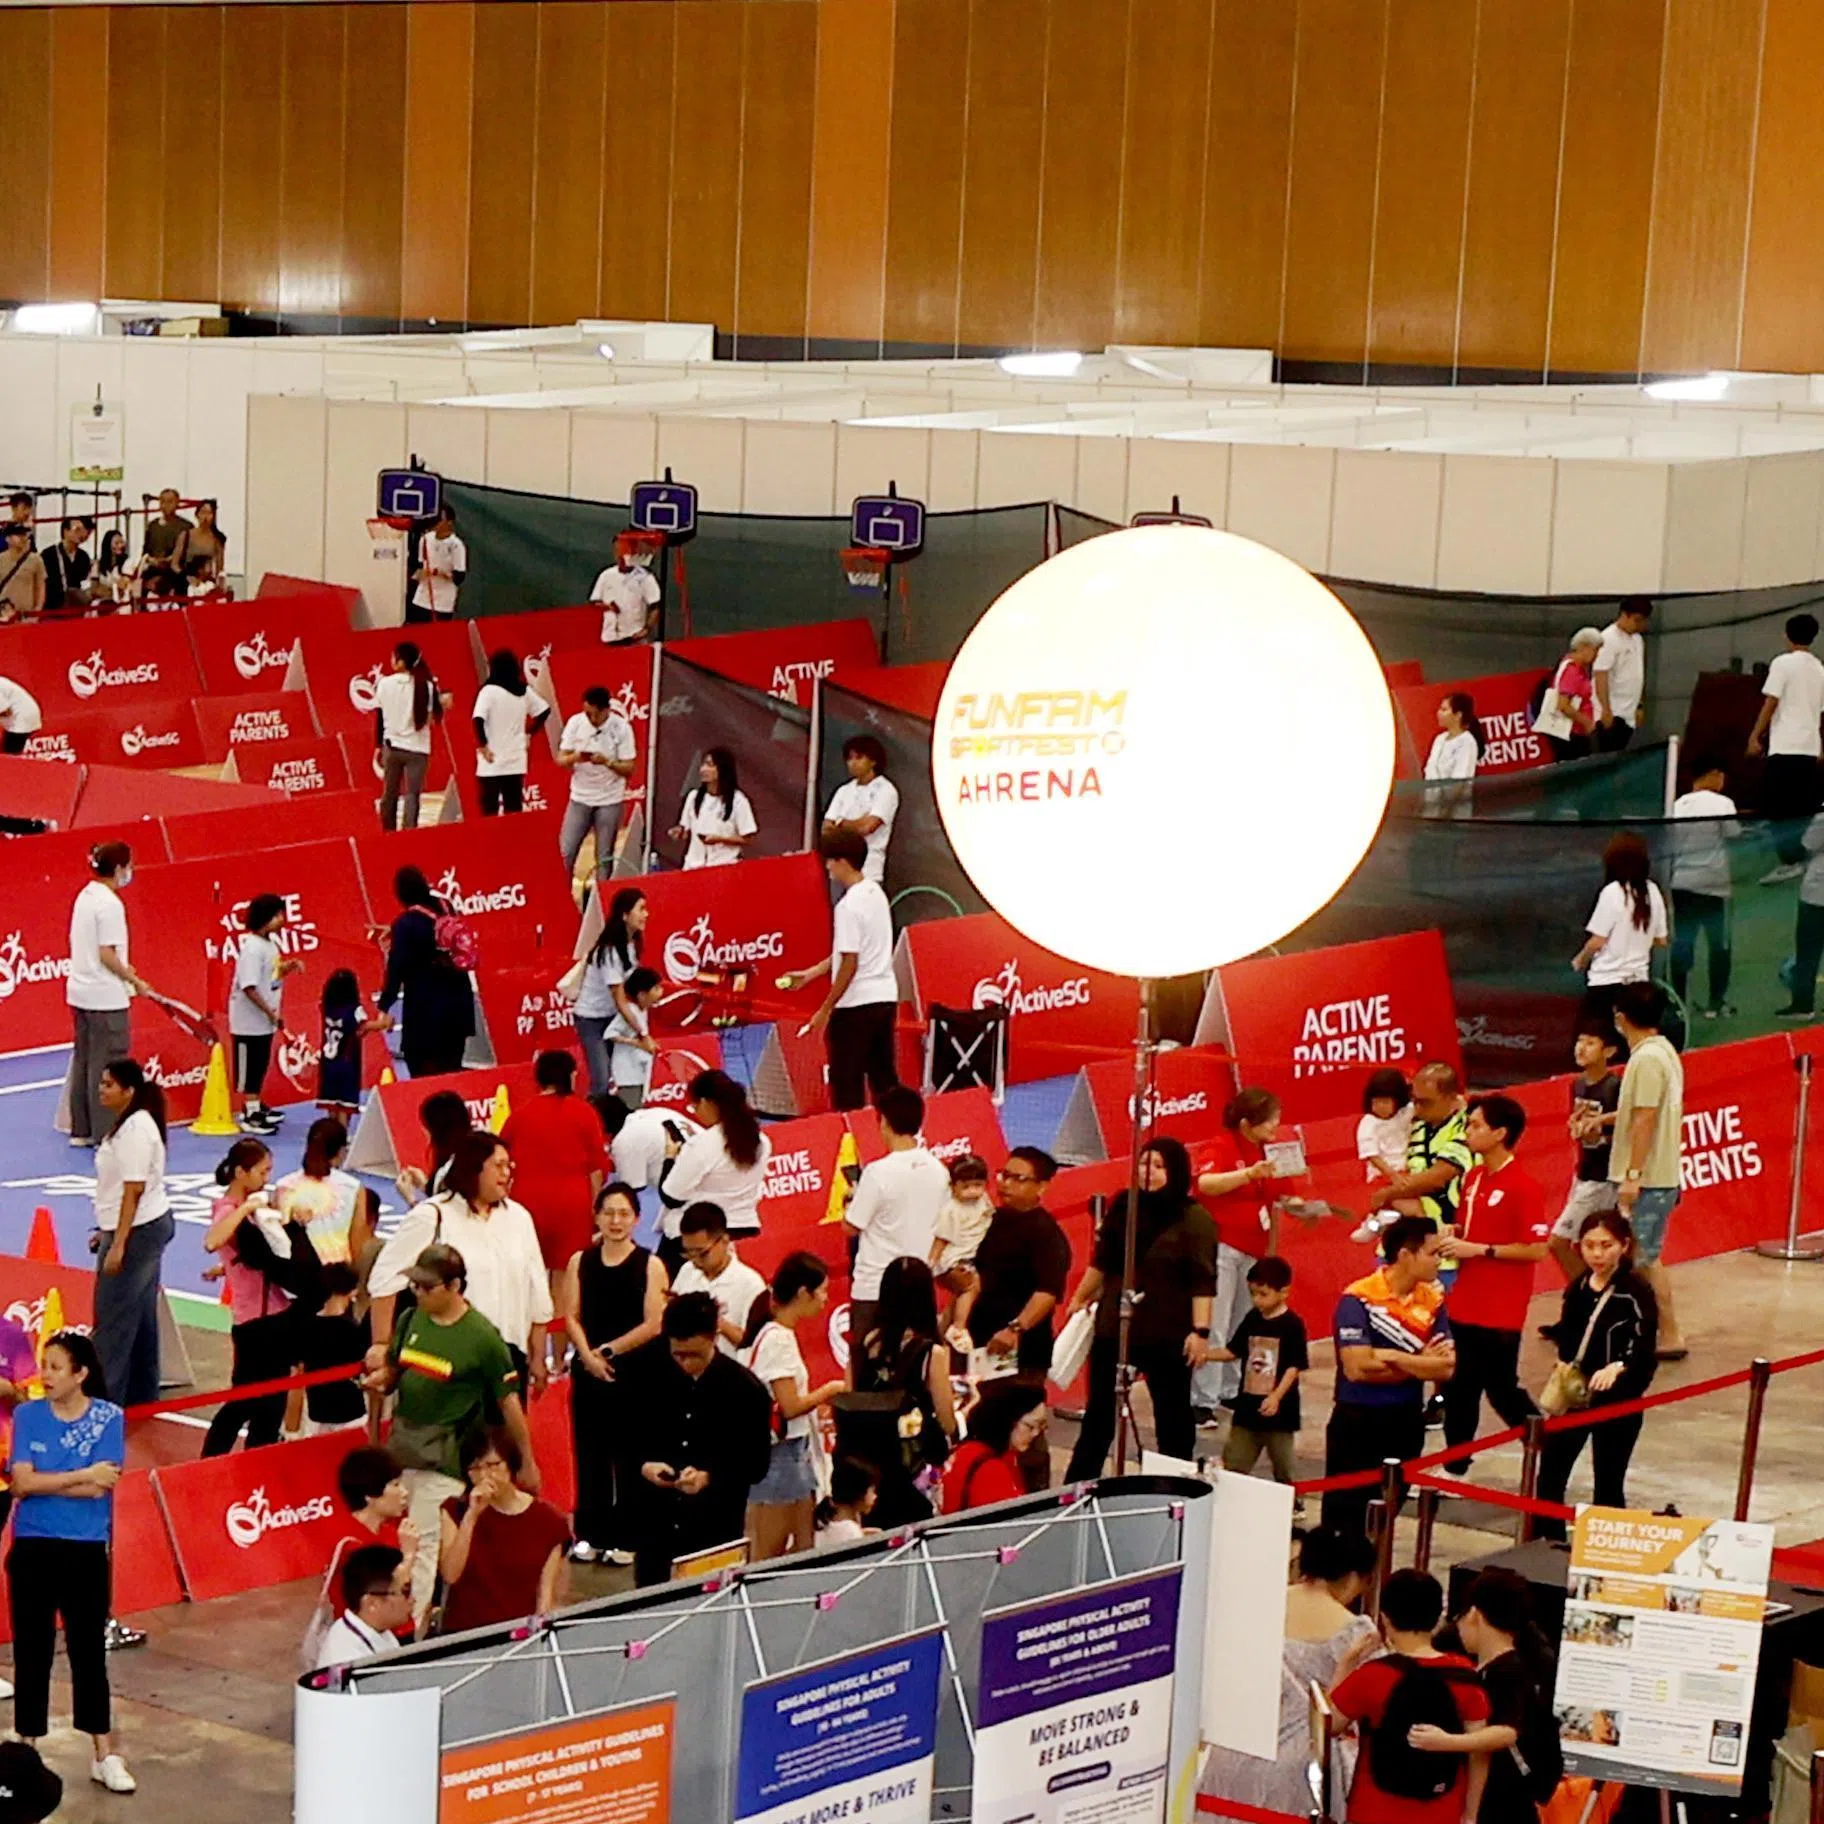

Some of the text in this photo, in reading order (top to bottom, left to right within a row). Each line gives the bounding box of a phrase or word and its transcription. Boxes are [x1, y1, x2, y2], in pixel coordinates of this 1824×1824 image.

[97, 662, 158, 691] ActiveSG
[772, 659, 835, 684] ACTIVE
[230, 722, 289, 743] PARENTS
[232, 710, 281, 732] ACTIVE
[268, 769, 324, 792] PARENTS
[272, 757, 317, 778] ACTIVE
[958, 769, 1101, 804] AHRENA
[452, 878, 526, 917] ActiveSG
[703, 931, 785, 965] ActiveSG
[1011, 977, 1091, 1014] ActiveSG
[1302, 996, 1392, 1042] ACTIVE
[1294, 1028, 1405, 1064] PARENTS
[1153, 1091, 1207, 1120] ActiveSG
[261, 1495, 333, 1530] ActiveSG
[1587, 1519, 1683, 1541] START YOUR
[1585, 1536, 1664, 1553] JOURNEY
[1029, 1699, 1140, 1746] MOVE STRONG &
[443, 1724, 665, 1788] SINGAPORE PHYSICAL ACTIVITY GUIDELINES
[1038, 1726, 1130, 1767] BE BALANCED
[467, 1785, 489, 1802] FOR
[493, 1776, 533, 1796] SCHOOL
[536, 1763, 588, 1785] CHILDREN
[601, 1748, 642, 1768] YOUTHS
[853, 1796, 863, 1814] &
[867, 1779, 917, 1808] THRIVE
